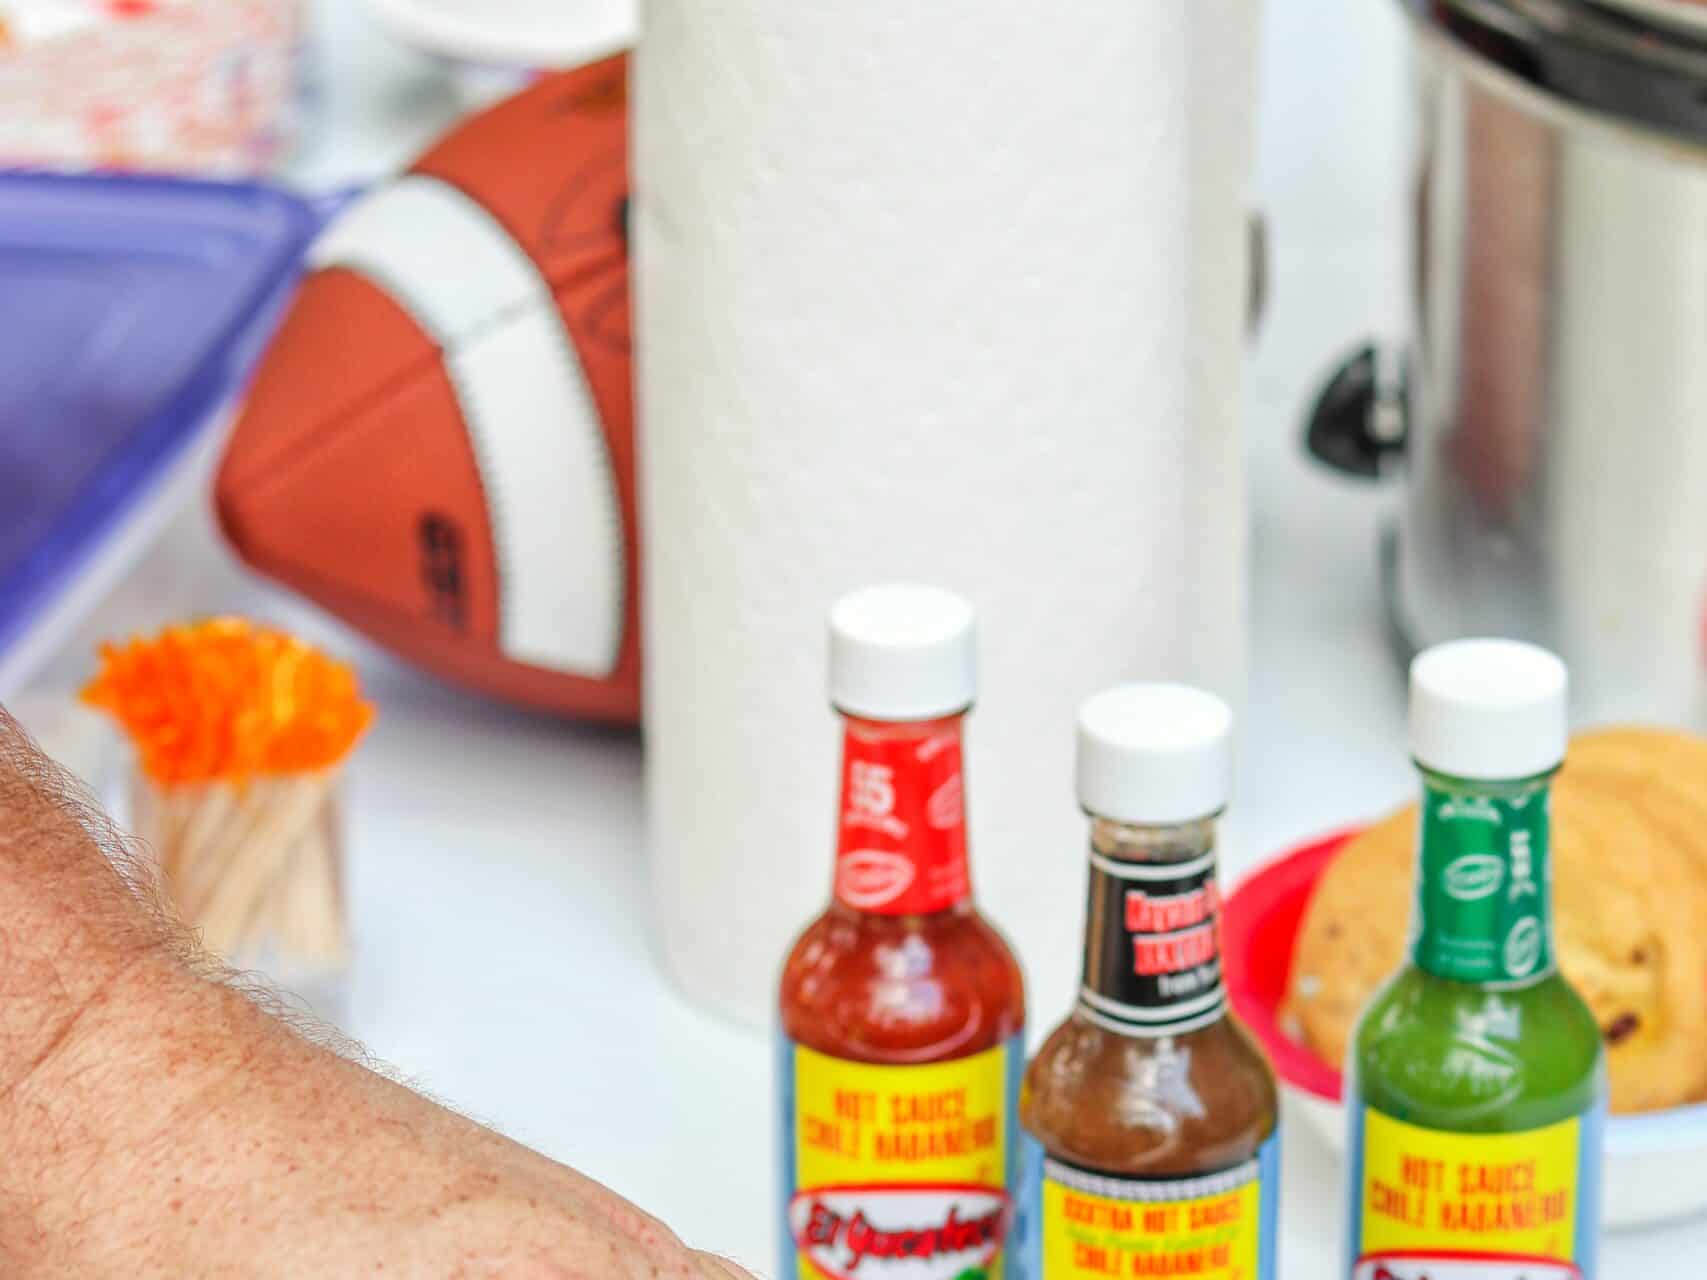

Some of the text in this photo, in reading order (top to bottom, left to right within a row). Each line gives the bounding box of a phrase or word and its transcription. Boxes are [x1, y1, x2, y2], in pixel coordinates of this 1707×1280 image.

[833, 1087, 966, 1124] HOT SAUCE
[1402, 1155, 1536, 1195] HOT SAUCE
[805, 1197, 845, 1248] El
[1143, 1207, 1181, 1233] HOT
[1188, 1193, 1243, 1230] SAUCE
